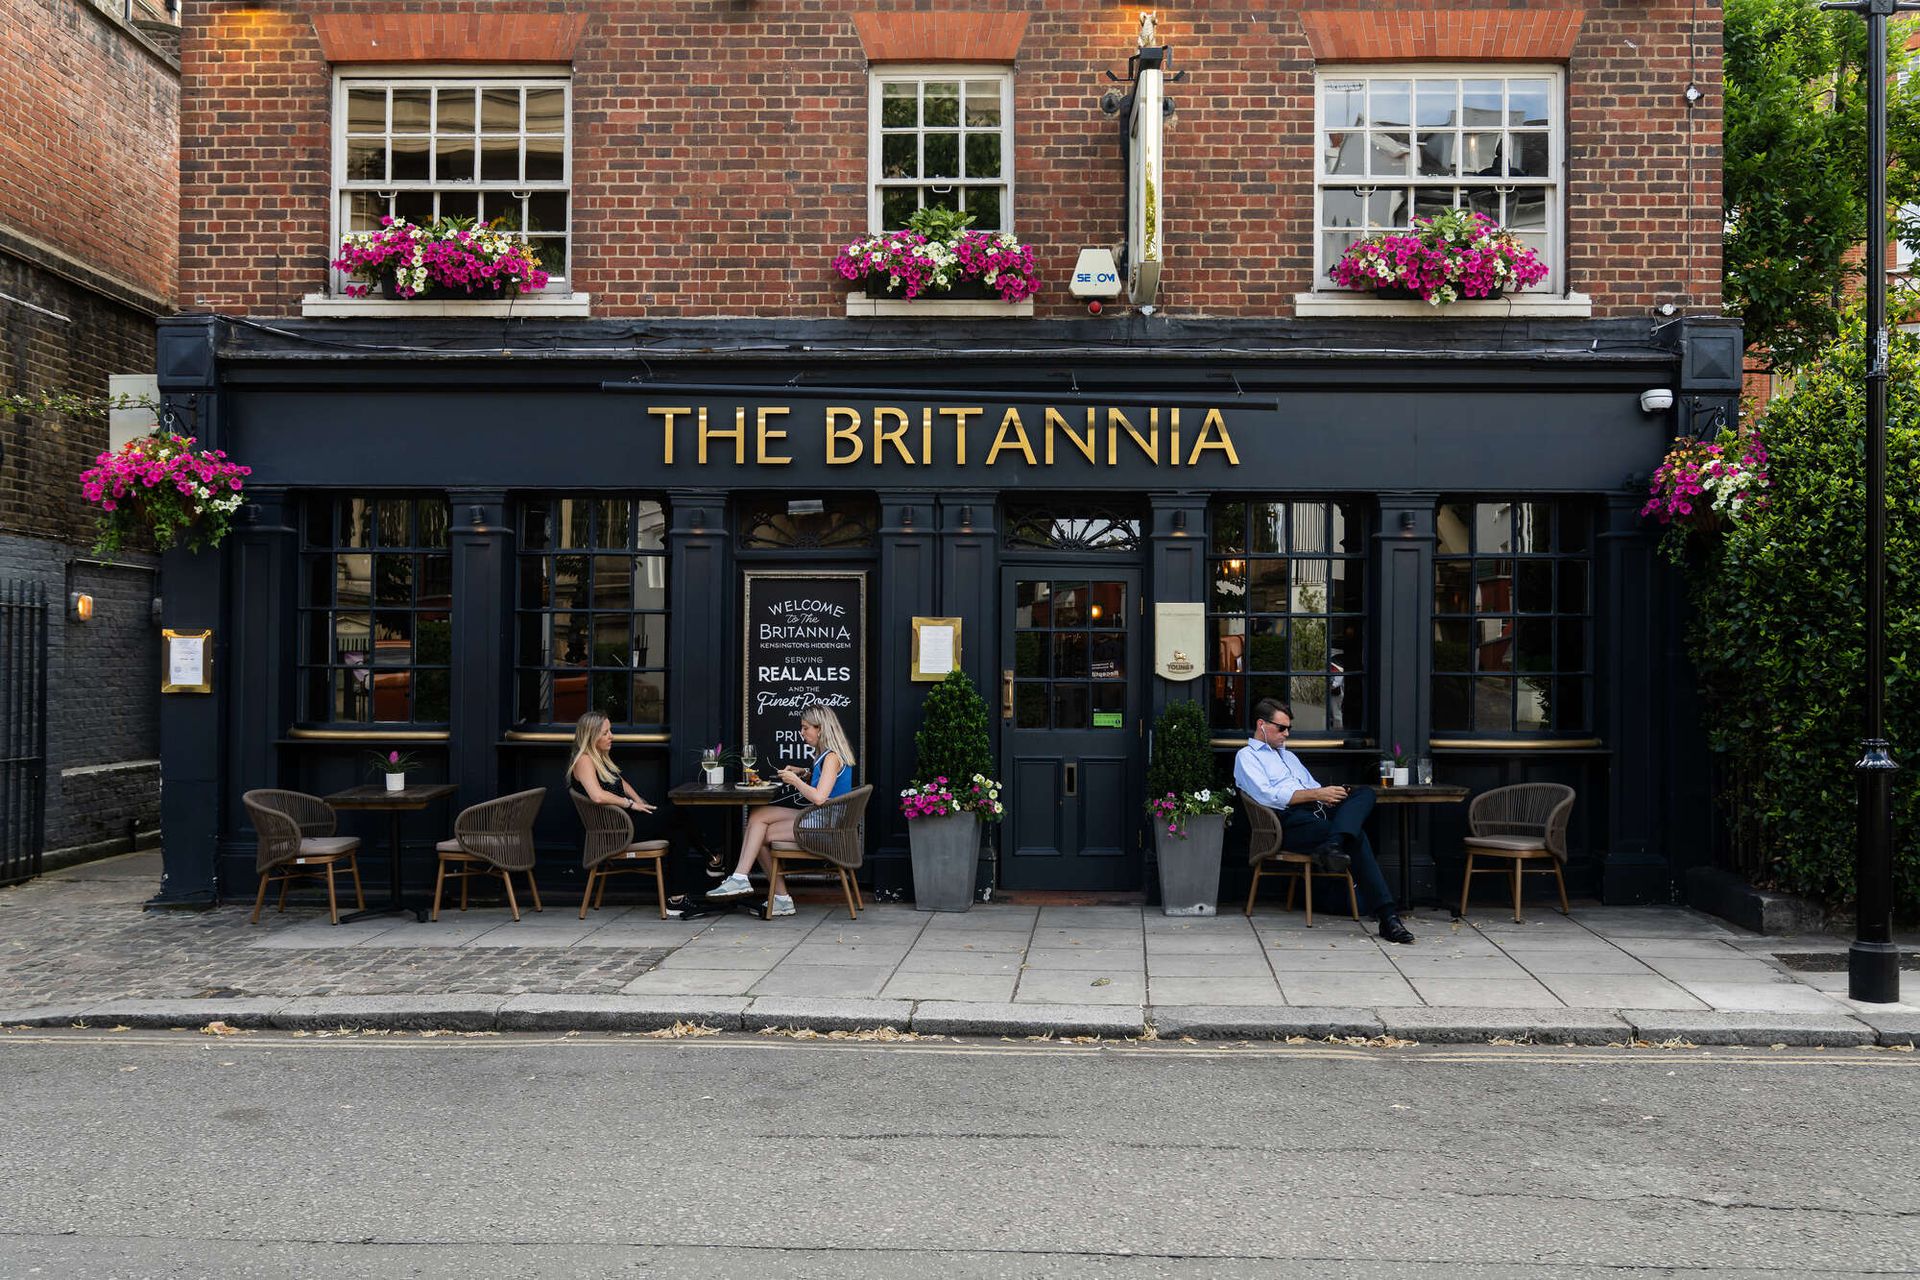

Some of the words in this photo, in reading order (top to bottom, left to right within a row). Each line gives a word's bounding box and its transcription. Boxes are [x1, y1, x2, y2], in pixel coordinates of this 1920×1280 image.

[1077, 273, 1115, 283] SEOM
[648, 407, 792, 464] THE
[826, 407, 1240, 465] BRITANNIA
[768, 599, 846, 618] WELCOME
[785, 614, 799, 624] to
[799, 613, 820, 624] The
[760, 623, 851, 641] BRITANNIA
[784, 656, 824, 664] SERVING
[758, 666, 802, 683] REAL
[804, 666, 851, 682] ALES
[757, 691, 802, 715] Finest
[801, 692, 852, 710] Roasts
